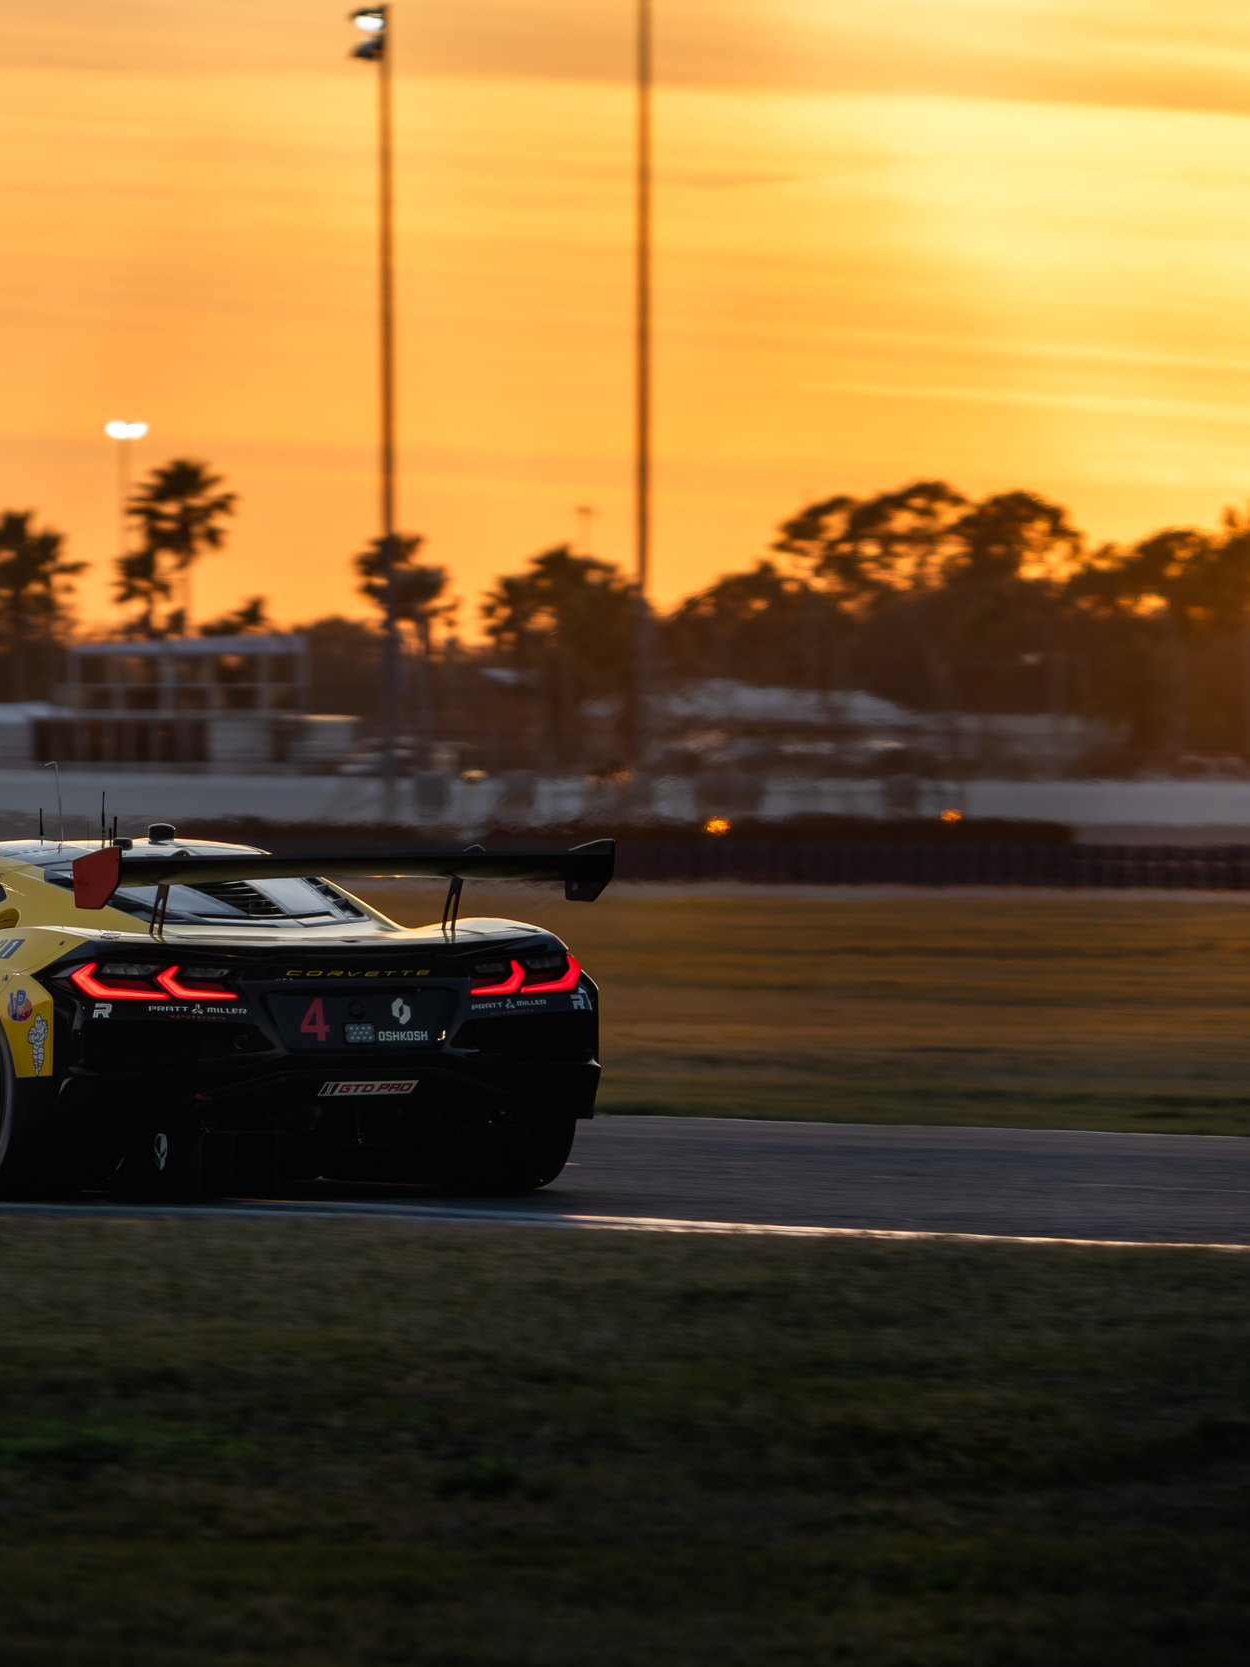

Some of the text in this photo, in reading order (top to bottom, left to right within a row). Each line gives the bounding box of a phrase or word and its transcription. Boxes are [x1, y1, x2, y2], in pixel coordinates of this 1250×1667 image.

[285, 969, 431, 977] CORVETTE
[147, 1005, 248, 1015] PRATT MILLER
[471, 1002, 503, 1010] PRATT
[300, 997, 331, 1042] 4
[378, 1030, 429, 1042] OSHKOSH
[339, 1083, 414, 1093] GTD PRO
